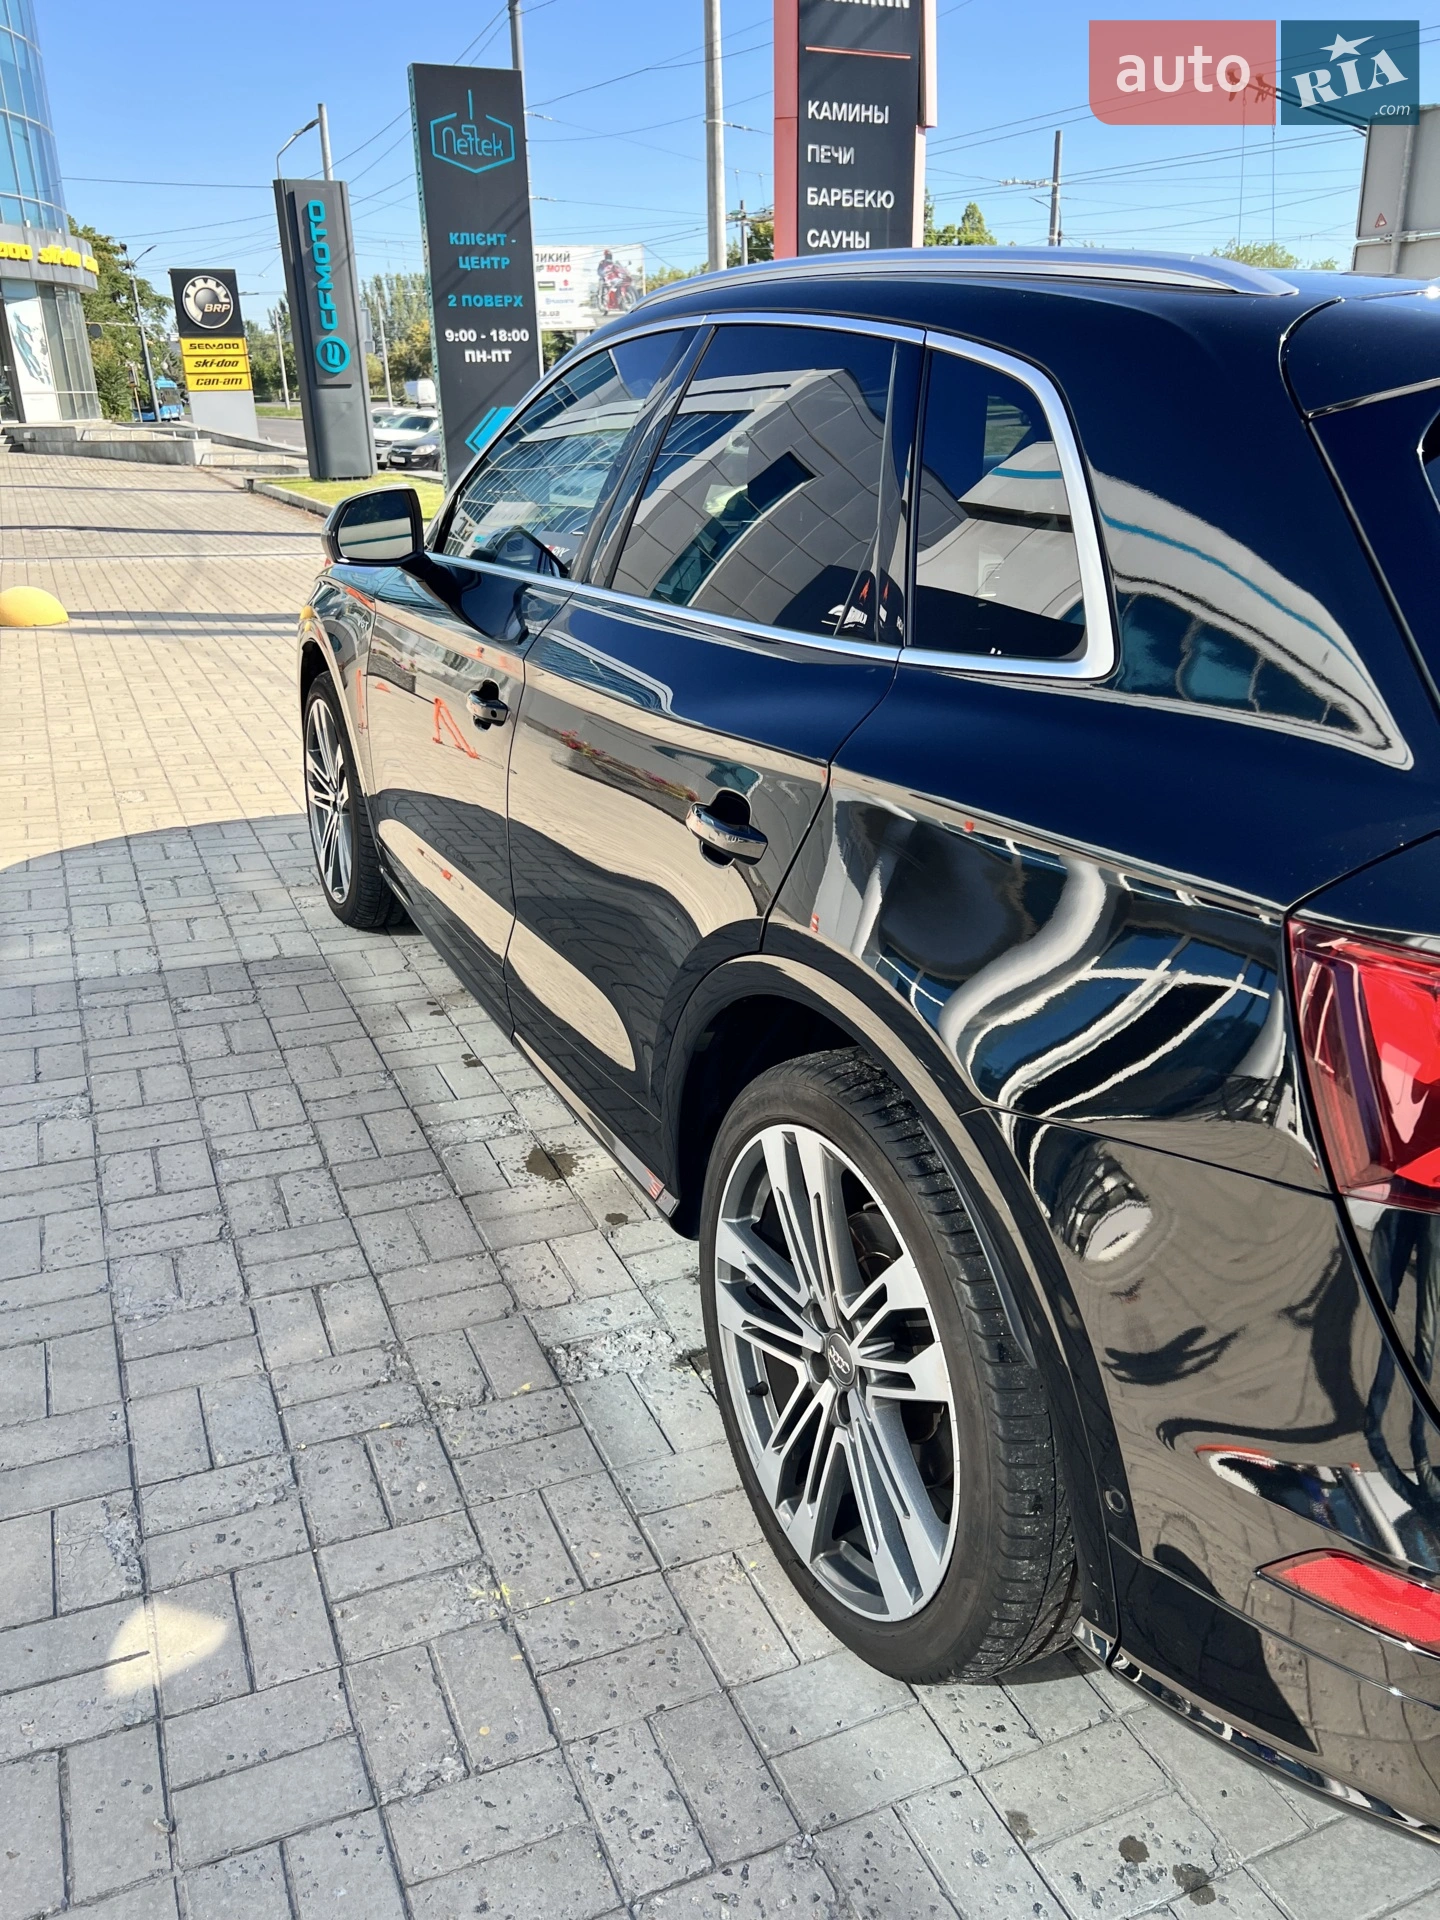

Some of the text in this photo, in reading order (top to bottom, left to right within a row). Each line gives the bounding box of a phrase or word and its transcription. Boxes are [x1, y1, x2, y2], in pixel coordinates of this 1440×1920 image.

[807, 100, 889, 124] КАМИНЫ
[807, 144, 855, 165] ПЕЧИ
[807, 187, 895, 209] БАРБЕКЮ
[449, 232, 507, 246] КЛІЄНТ
[807, 229, 870, 249] САУНЫ
[308, 199, 339, 331] CFMOTO
[458, 256, 510, 271] ЦЕНТР
[204, 303, 231, 313] BRP
[447, 294, 524, 308] 2 ПОВЕРХ
[444, 329, 478, 342] 9:00
[490, 329, 530, 342] 18:00
[464, 349, 512, 363] ПН-ПТ
[194, 359, 239, 368] ski-doo
[195, 377, 243, 386] can-am
